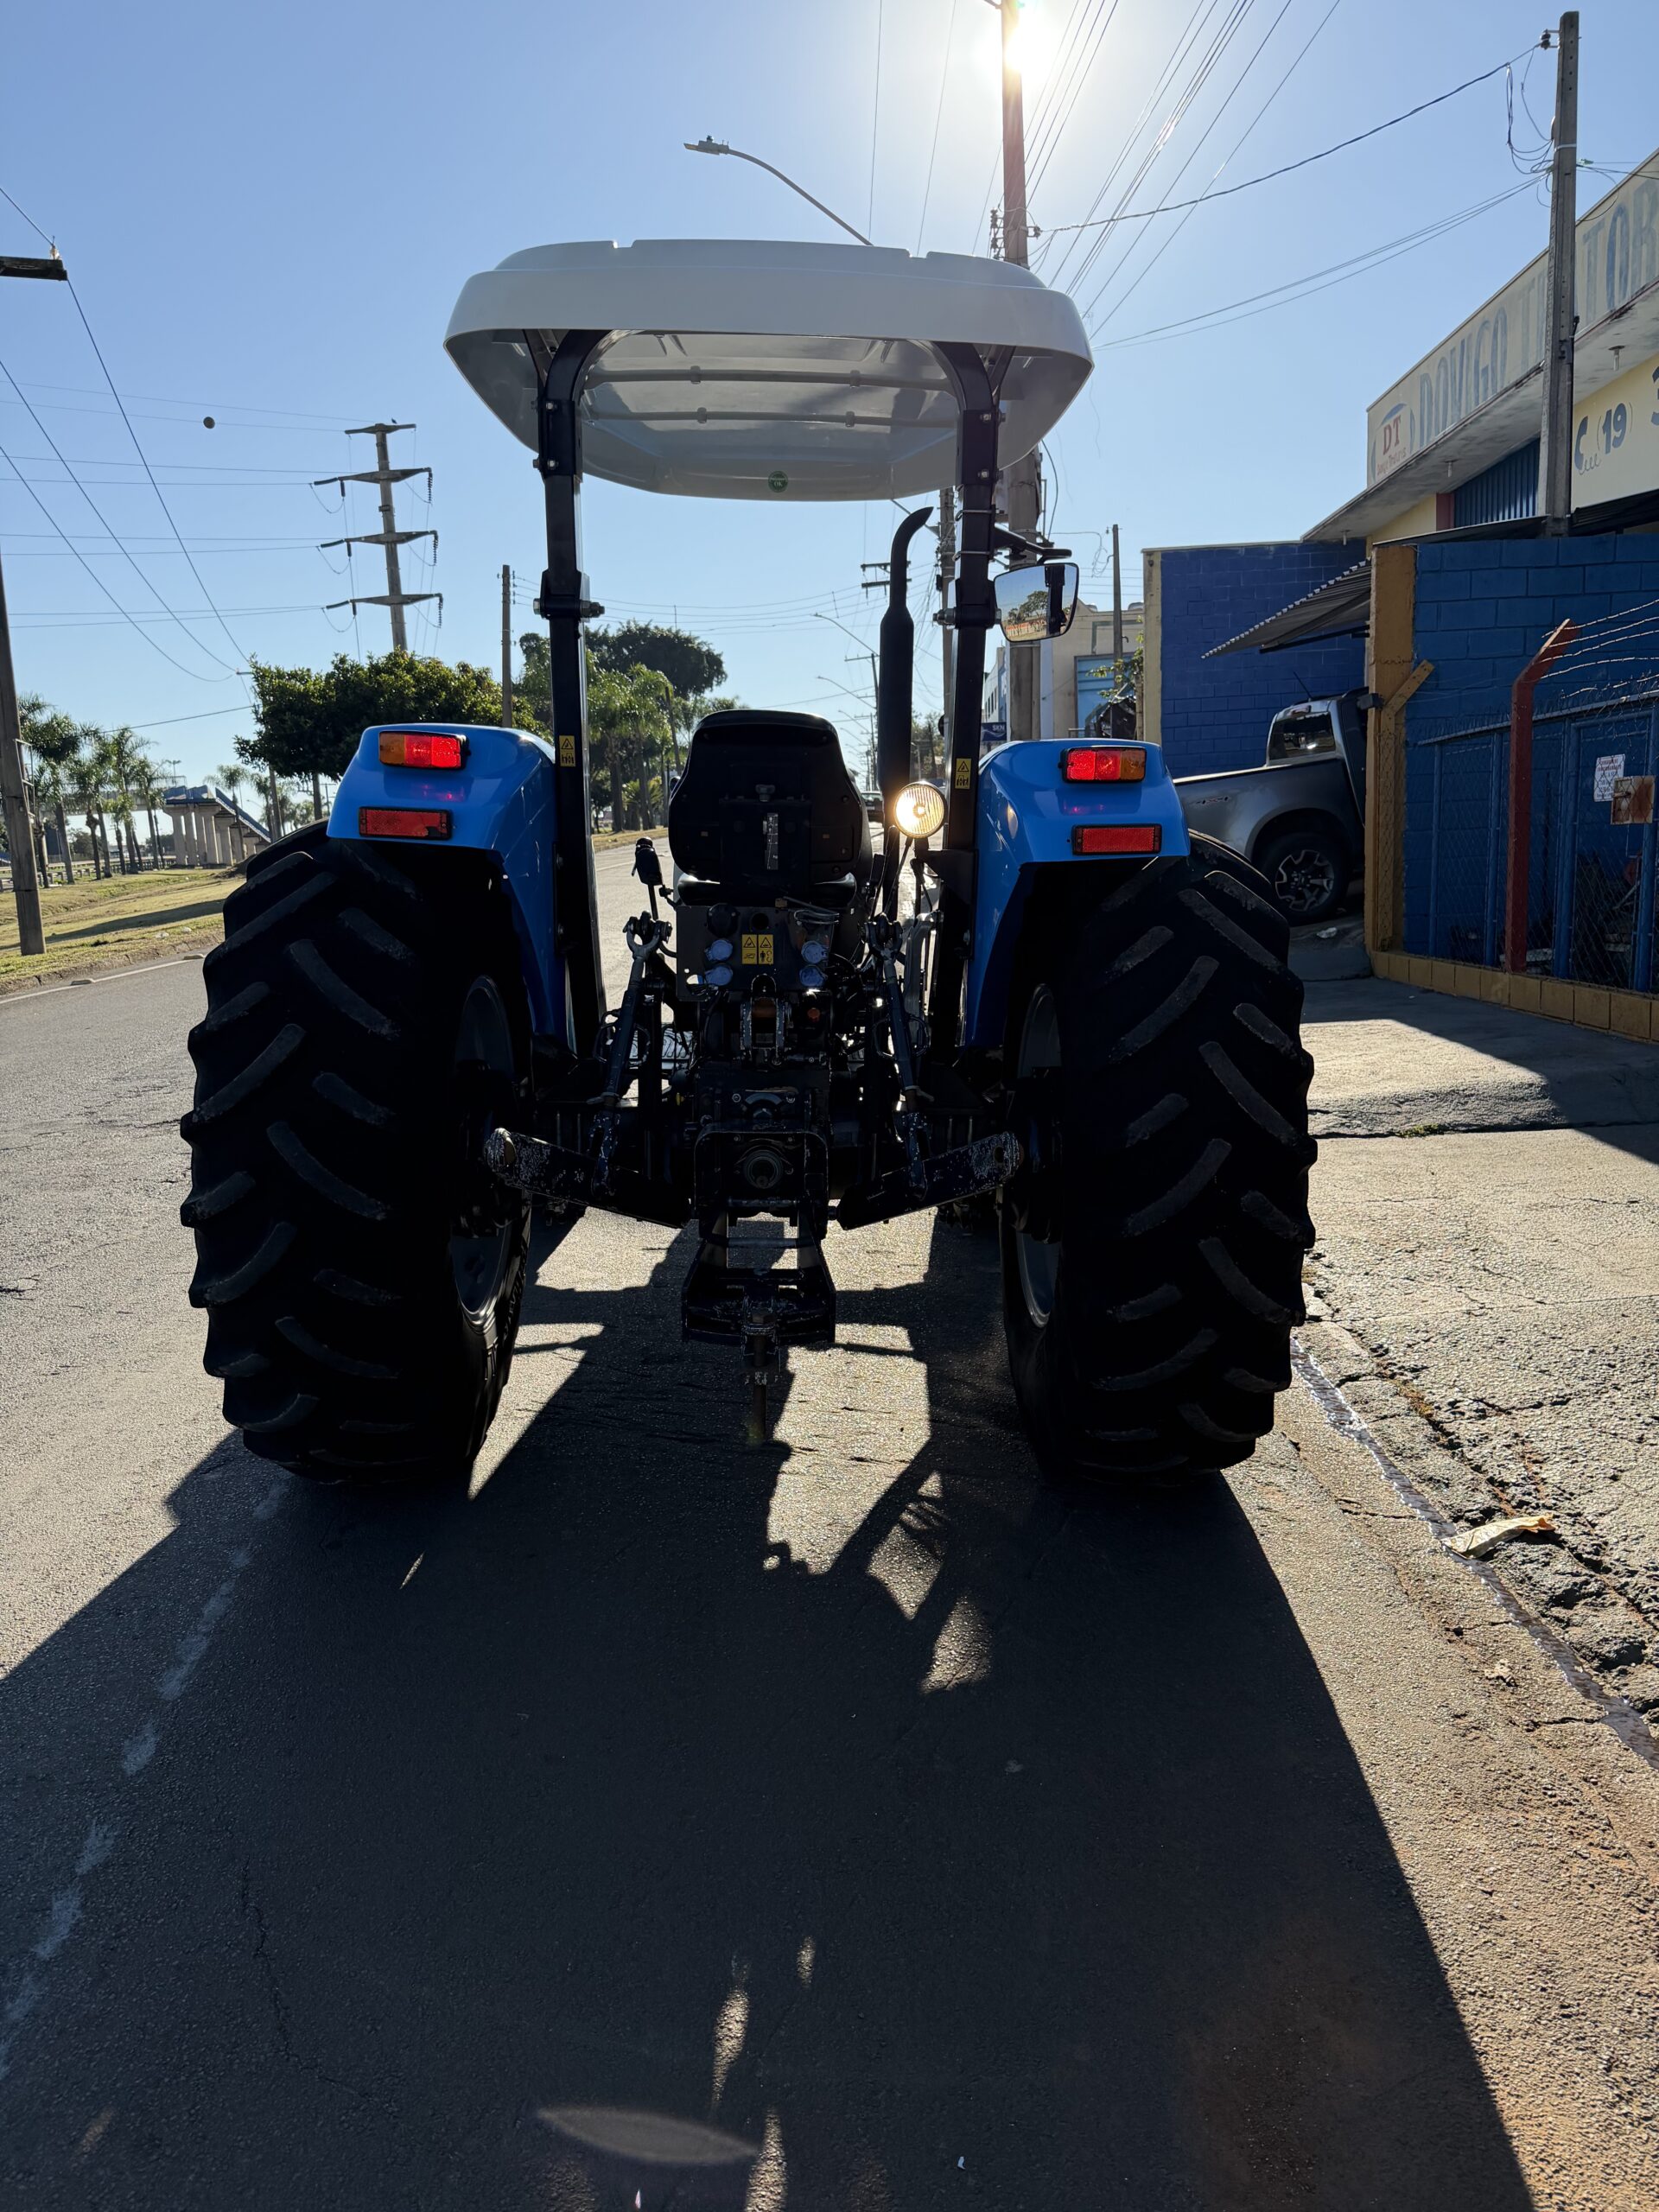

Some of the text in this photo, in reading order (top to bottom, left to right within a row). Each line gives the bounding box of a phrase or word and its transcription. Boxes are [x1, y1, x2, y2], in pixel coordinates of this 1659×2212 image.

[1420, 306, 1507, 448] DOVIGO
[1521, 177, 1659, 372] TTOR
[1382, 414, 1402, 455] DT
[1596, 402, 1633, 454] (19)
